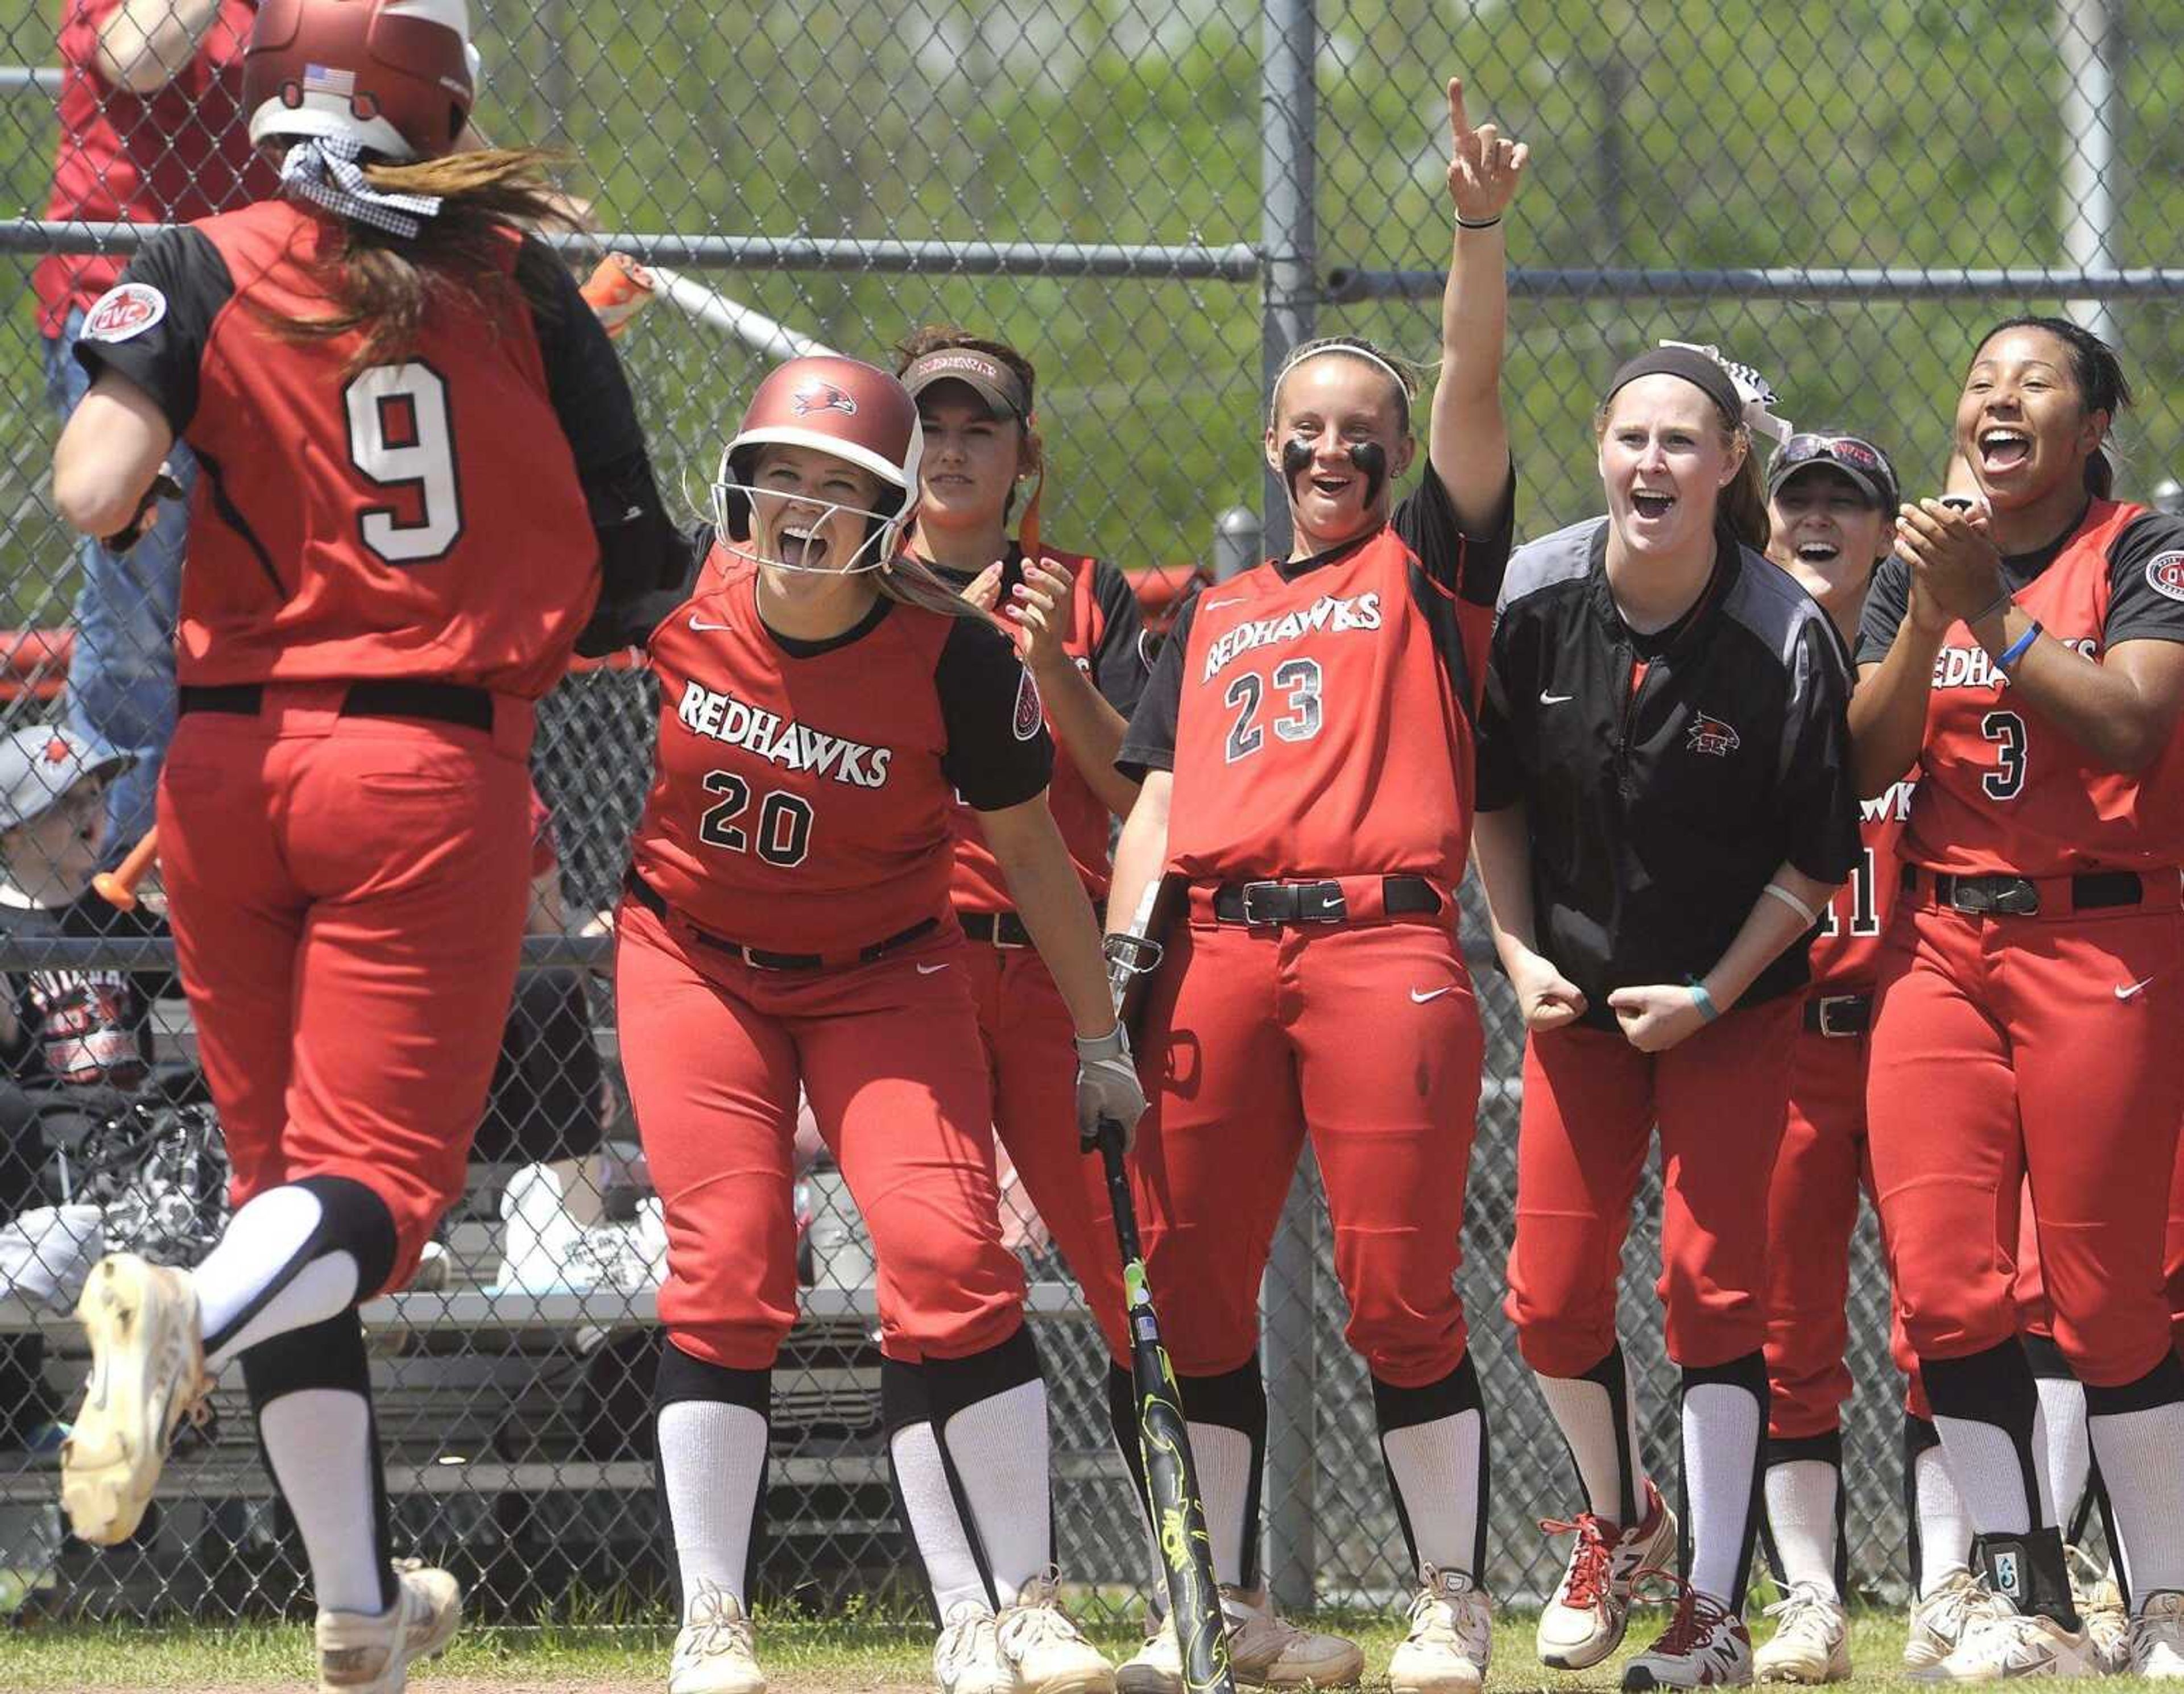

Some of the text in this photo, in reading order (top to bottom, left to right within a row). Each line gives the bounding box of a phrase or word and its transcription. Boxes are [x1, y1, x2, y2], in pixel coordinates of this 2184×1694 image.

[341, 357, 464, 565] 9
[1198, 593, 1381, 685] REDHAWKS
[678, 679, 892, 788] REDHAWKS
[1224, 657, 1322, 763] 23
[1982, 711, 2027, 800] 3
[699, 769, 814, 868] 20
